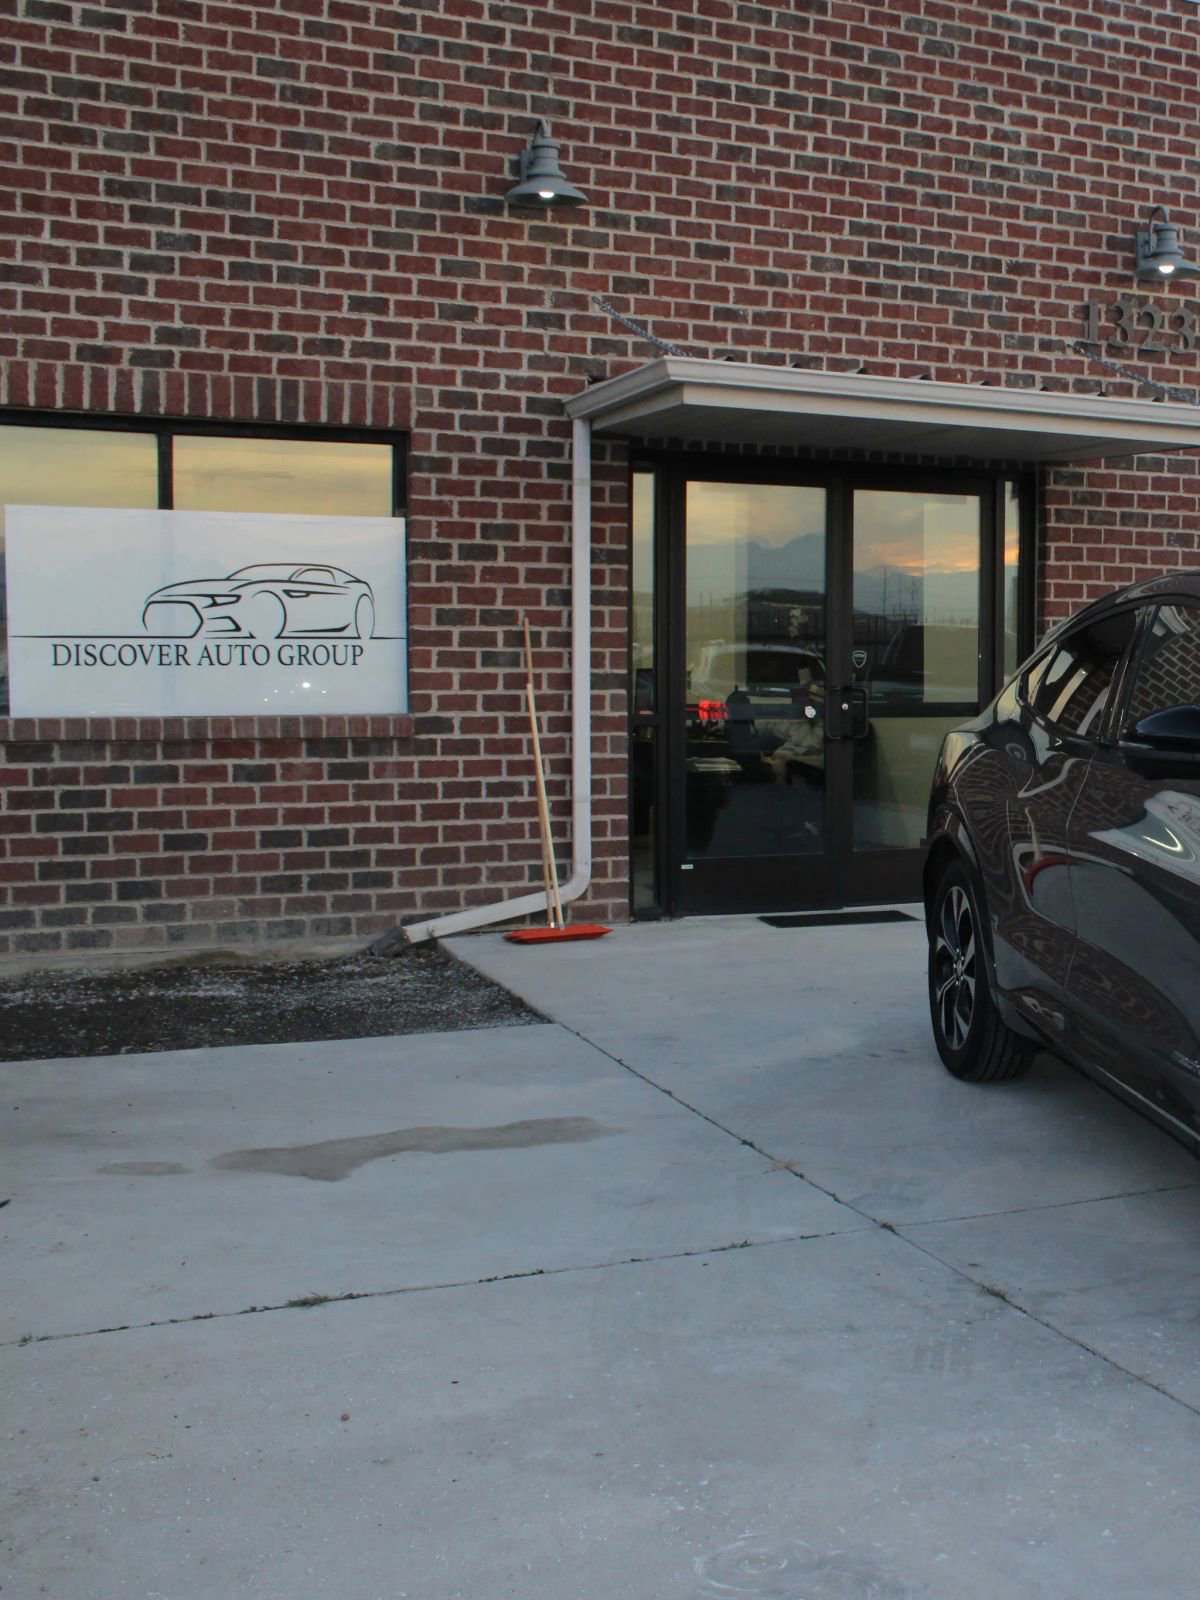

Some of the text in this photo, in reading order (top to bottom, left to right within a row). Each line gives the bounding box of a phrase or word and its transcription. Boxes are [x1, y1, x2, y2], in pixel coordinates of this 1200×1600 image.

[51, 643, 364, 666] DISCOVER AUTO GROUP
